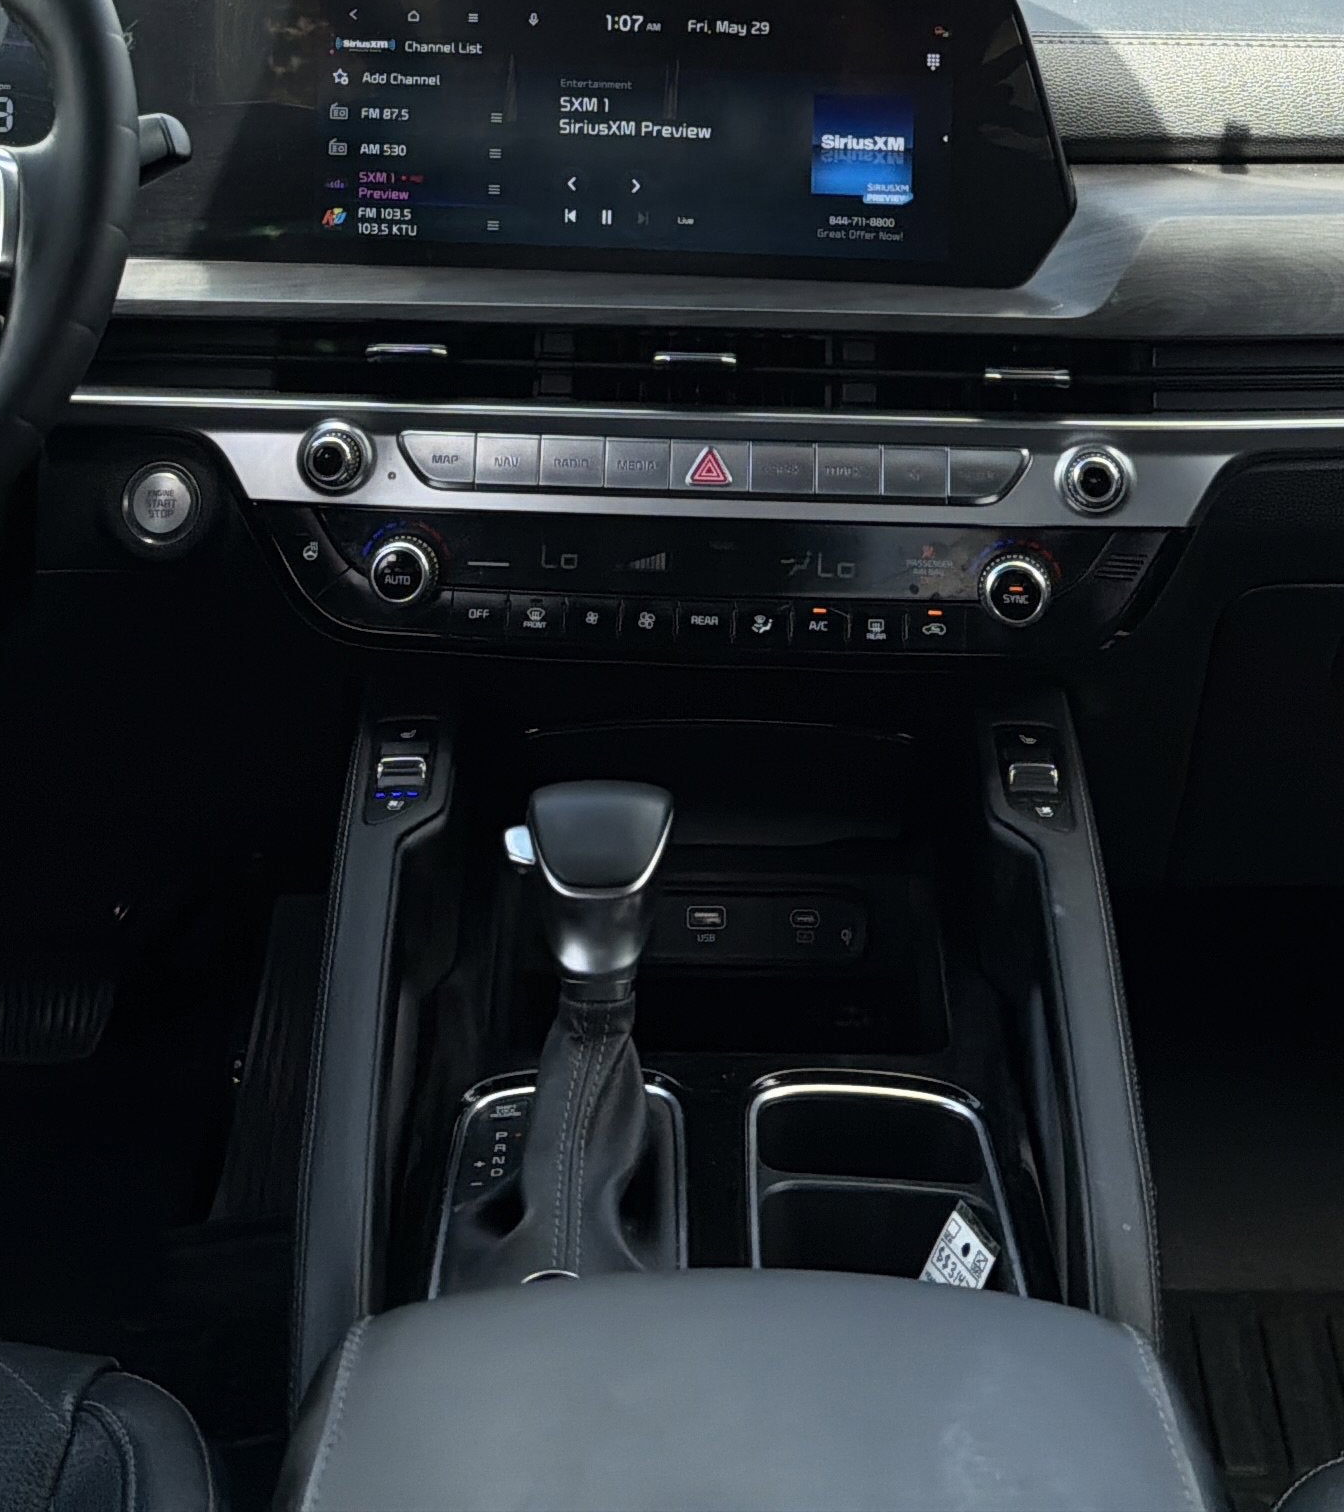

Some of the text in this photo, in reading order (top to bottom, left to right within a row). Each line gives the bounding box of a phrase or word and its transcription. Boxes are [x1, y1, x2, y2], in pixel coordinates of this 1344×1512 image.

[605, 14, 662, 32] 1:07 AM
[716, 20, 747, 37] May
[750, 21, 770, 35] 29
[404, 40, 456, 54] Channel
[458, 41, 483, 55] List
[362, 72, 441, 86] Add Channel
[560, 78, 633, 90] Entertainment
[559, 96, 610, 113] SXM 1
[360, 107, 410, 121] FM 87.5
[559, 119, 712, 140] SiriusXM Preview
[821, 134, 905, 152] SiriusXM
[359, 143, 407, 157] AM 530
[358, 171, 387, 183] SXM
[390, 171, 396, 183] 1
[358, 186, 410, 200] Preview
[358, 207, 377, 220] FM
[380, 208, 412, 221] 103.5
[828, 215, 896, 228] 844-711-8800
[357, 223, 417, 237] 103.5 KTU
[816, 228, 904, 242] Great Offer Now!
[431, 454, 459, 465] MAP
[494, 456, 520, 467] NAV
[617, 459, 657, 471] MEDIA
[384, 575, 411, 585] AUTO
[1002, 594, 1029, 605] SYNC
[468, 608, 490, 619] OFF
[522, 620, 547, 629] FRONT
[690, 615, 719, 626] REAR
[808, 620, 828, 632] A/C
[696, 933, 716, 943] USB
[495, 1131, 508, 1141] P
[492, 1156, 506, 1165] N
[490, 1167, 504, 1177] D
